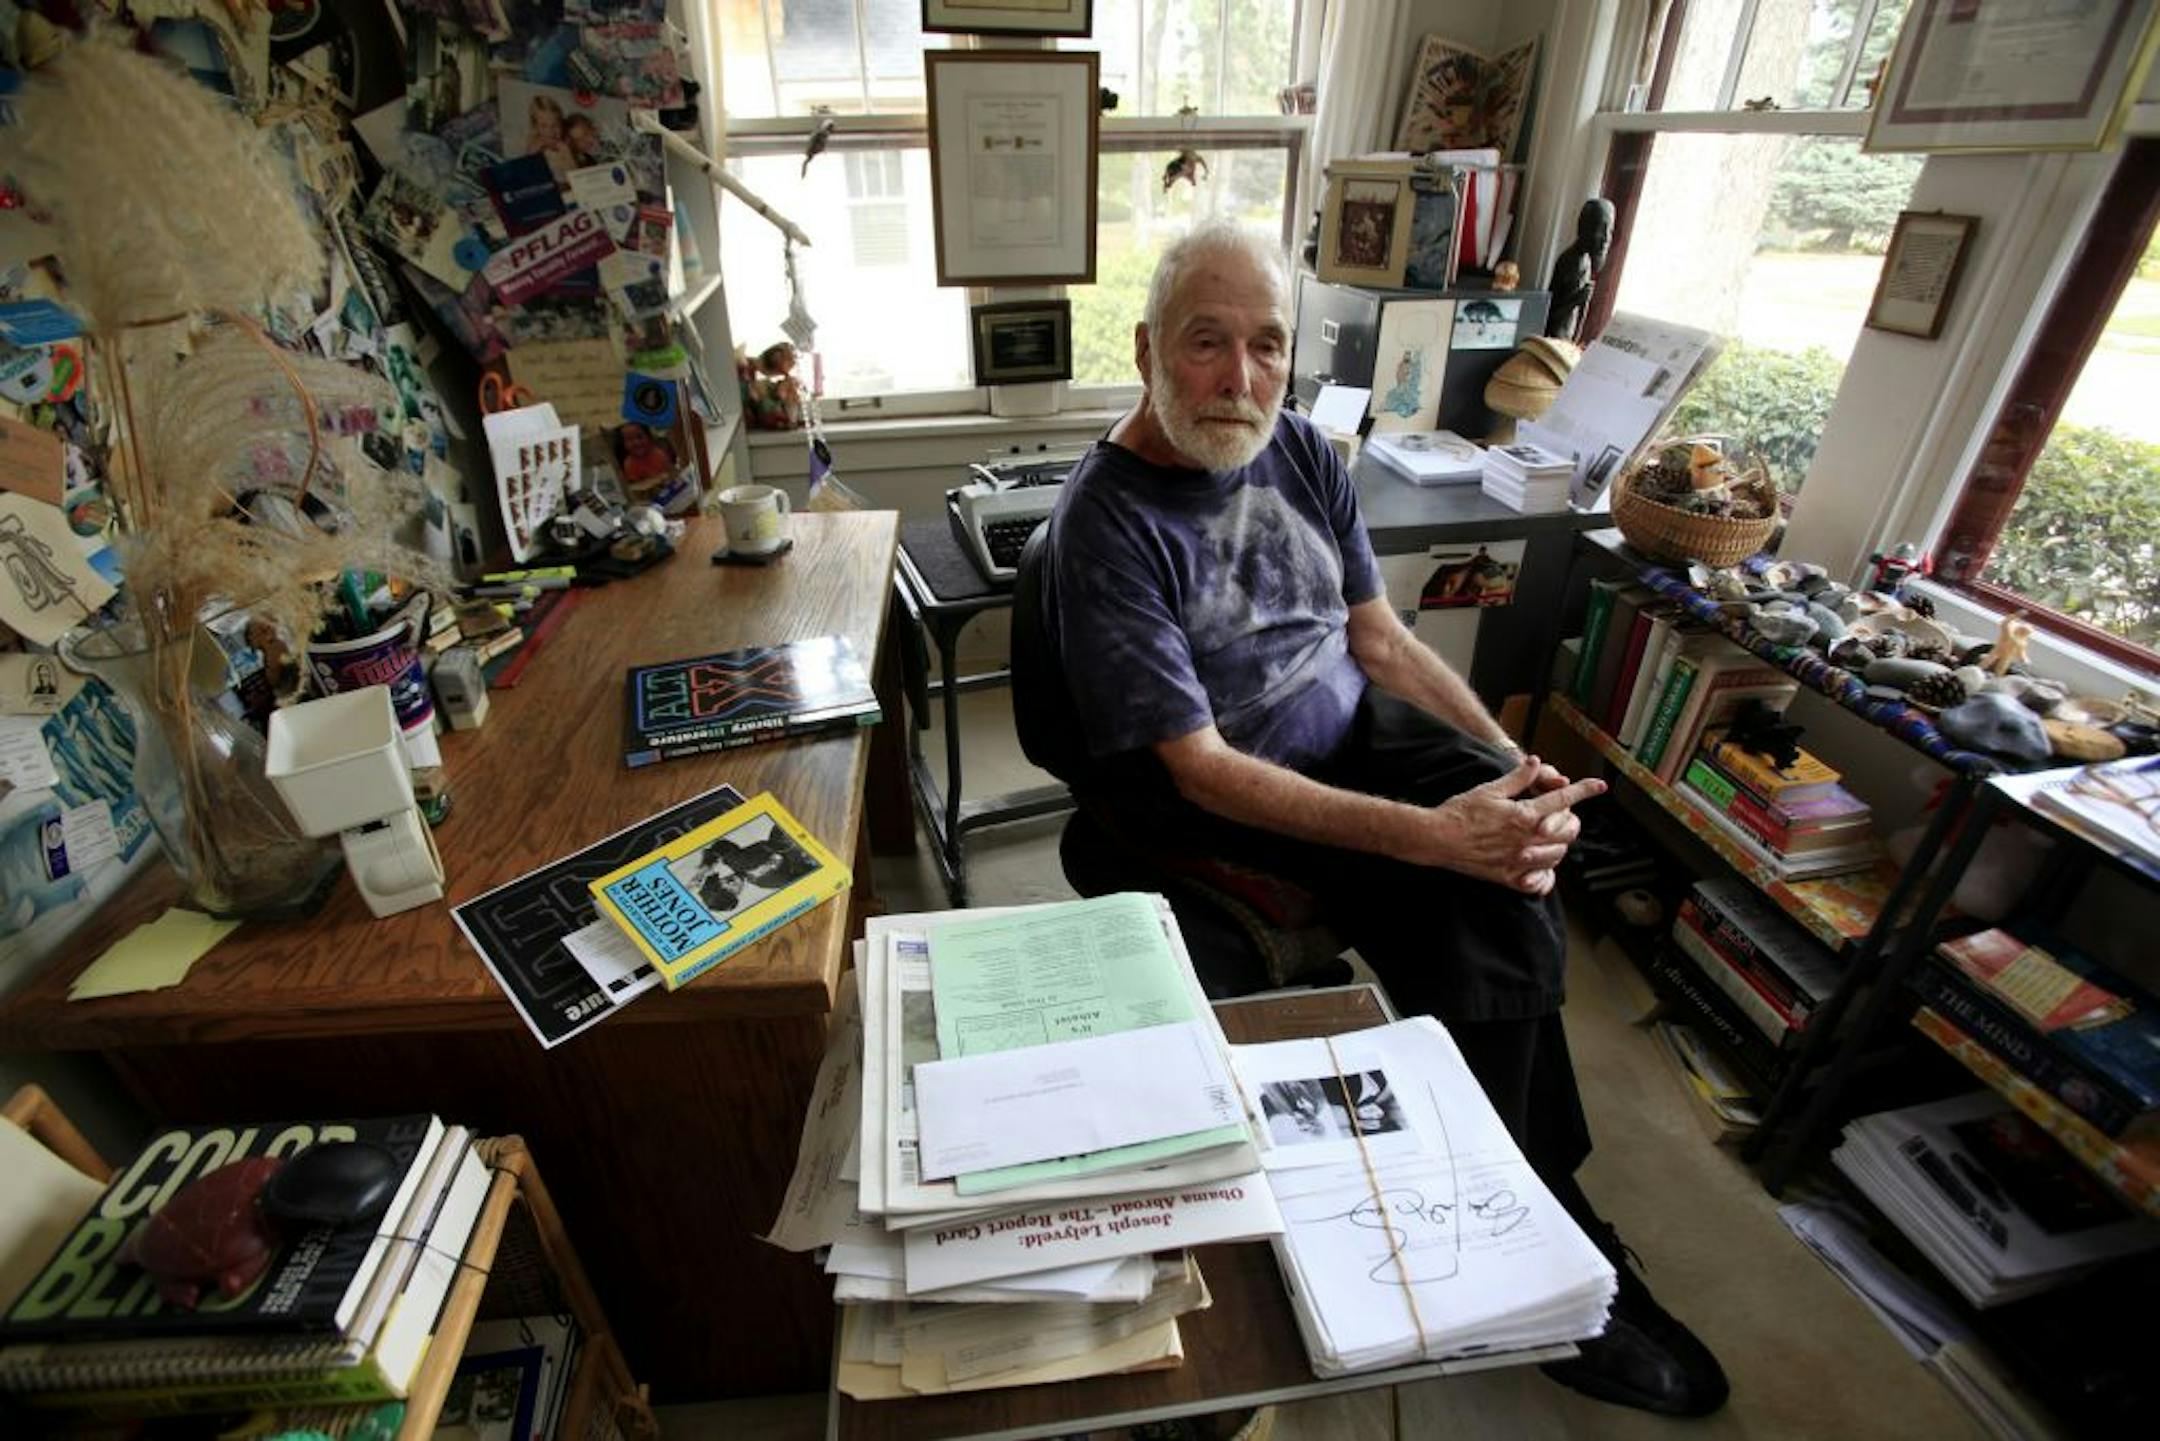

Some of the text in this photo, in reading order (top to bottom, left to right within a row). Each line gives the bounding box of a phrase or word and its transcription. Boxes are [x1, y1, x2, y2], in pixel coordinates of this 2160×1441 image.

[509, 212, 594, 268] PFLAG
[648, 718, 785, 747] library literature
[621, 876, 693, 953] MOTHER
[649, 877, 712, 934] JONES
[1937, 984, 2034, 1062] THE MIND
[1182, 1187, 1244, 1203] Obama
[936, 1226, 981, 1246] Card
[989, 1214, 1053, 1236] Report
[1019, 1213, 1173, 1248] Joseph Lelyveld:
